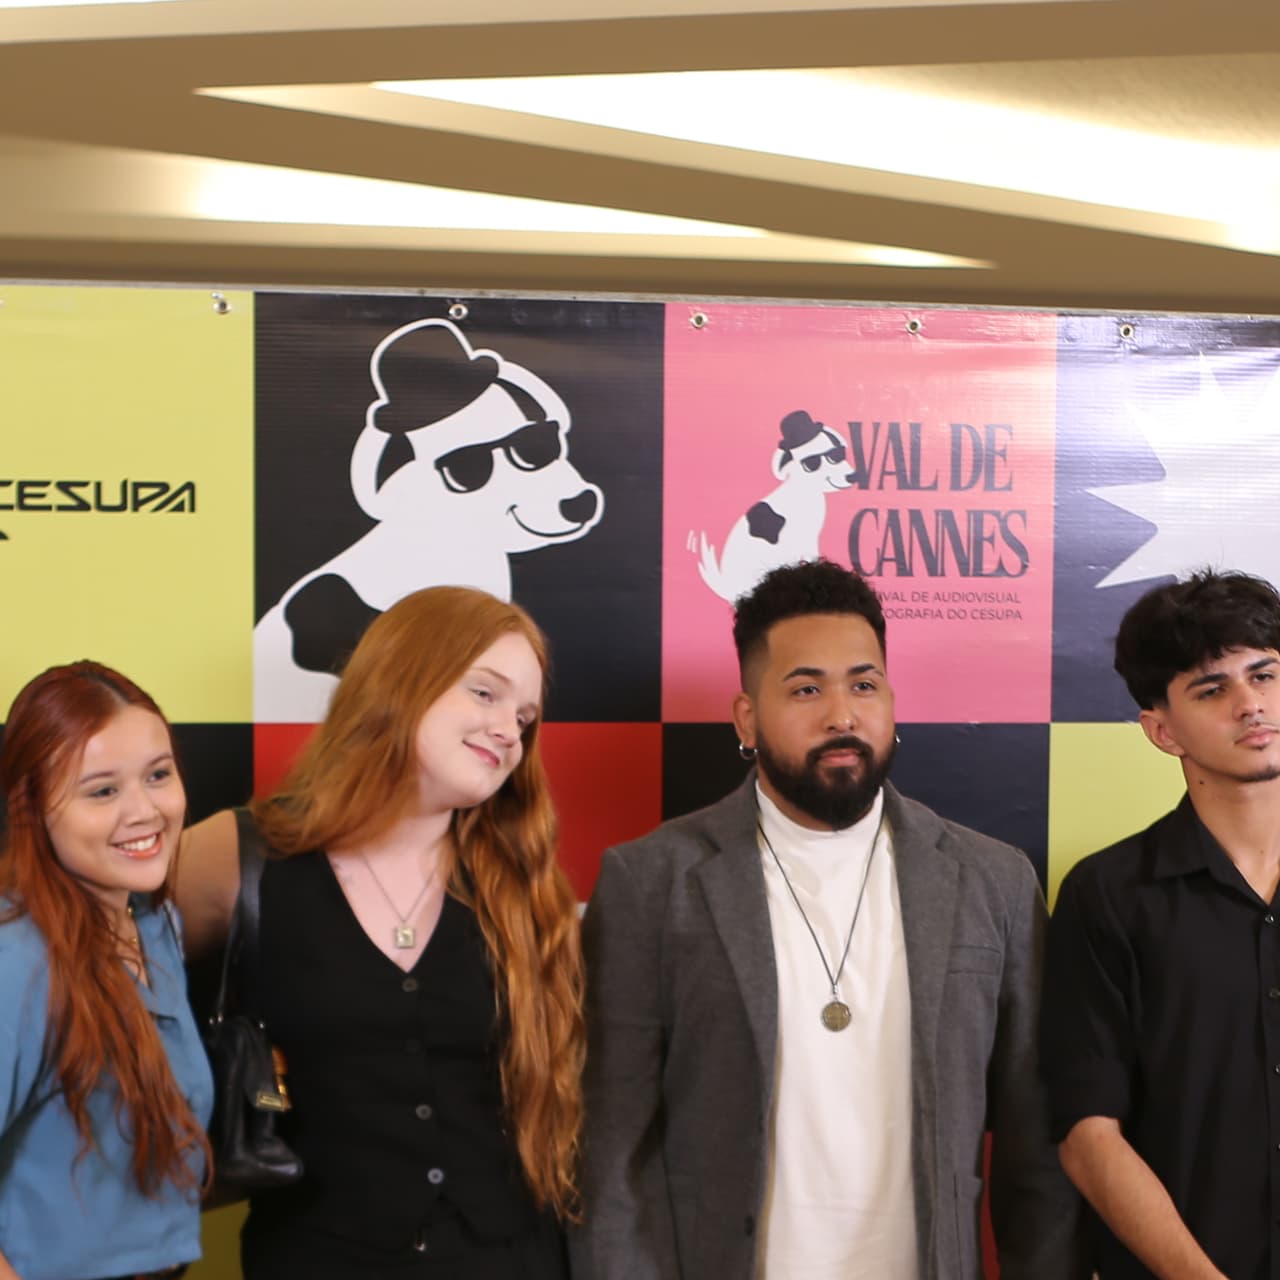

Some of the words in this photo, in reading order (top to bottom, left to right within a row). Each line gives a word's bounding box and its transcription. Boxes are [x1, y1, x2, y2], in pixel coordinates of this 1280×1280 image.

[848, 421, 939, 491] VAL
[949, 422, 1014, 492] DE
[848, 507, 1030, 578] CANNES
[911, 591, 929, 603] DE
[933, 591, 1022, 604] AUDIOVISUAL
[947, 608, 967, 620] DO
[971, 608, 1023, 621] CESUPA
